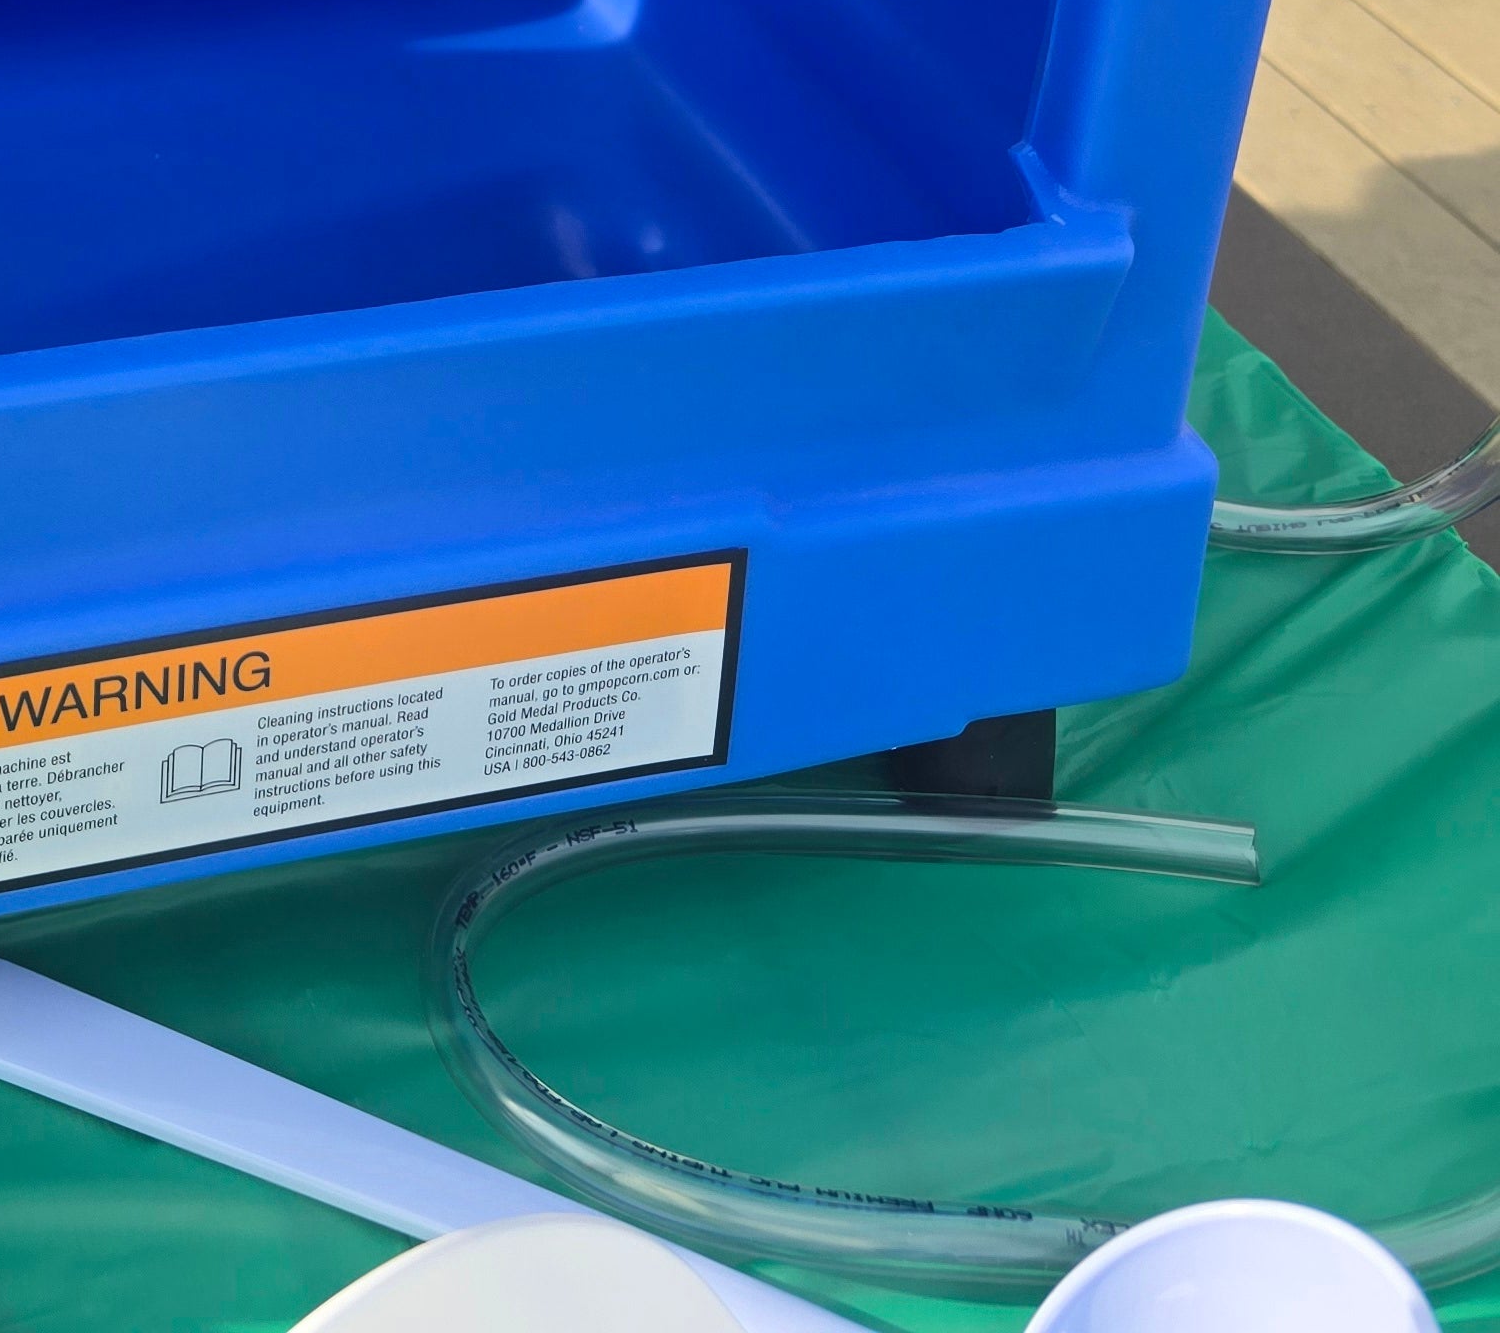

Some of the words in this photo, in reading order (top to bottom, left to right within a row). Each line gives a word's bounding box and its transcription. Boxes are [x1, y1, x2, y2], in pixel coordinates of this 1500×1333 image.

[489, 689, 537, 707] manual,
[542, 688, 558, 701] go
[562, 684, 574, 695] to
[578, 667, 679, 695] gmpopcorn.com
[683, 665, 700, 675] or:
[490, 677, 504, 690] To
[509, 672, 542, 687] order
[546, 665, 586, 681] copies
[590, 660, 603, 674] of
[606, 659, 625, 671] the
[258, 711, 312, 729] Cleaning
[318, 698, 393, 719] instructions
[398, 686, 443, 705] located
[488, 709, 516, 725] Gold
[521, 702, 558, 719] Medal
[562, 694, 617, 713] Products
[621, 690, 640, 702] Co.
[257, 735, 268, 747] in
[342, 713, 391, 732] manual.
[397, 707, 428, 723] Read
[487, 724, 526, 741] 10700
[530, 716, 589, 734] Medallion
[594, 710, 625, 724] Drive
[255, 749, 279, 765] and
[284, 736, 356, 760] understand
[485, 737, 549, 759] Cincinnati,
[554, 732, 582, 747] Ohio
[586, 724, 623, 741] 45241
[51, 751, 71, 765] est
[255, 762, 302, 782] manual
[306, 758, 330, 773] and
[334, 754, 348, 768] all
[353, 751, 386, 765] other
[390, 743, 427, 758] safety
[484, 760, 510, 775] USA
[522, 743, 610, 769] 800-543-0862
[6, 777, 41, 791] terre.
[47, 761, 124, 784] Débrancher
[254, 778, 330, 799] instructions
[335, 770, 375, 785] before
[379, 763, 413, 777] using
[418, 757, 440, 770] this
[5, 791, 61, 809] nettoyer,
[17, 813, 35, 825] les
[40, 799, 115, 820] couvercles.
[253, 794, 324, 817] equipment.
[39, 814, 117, 838] uniquement
[566, 819, 639, 846] NSF-51
